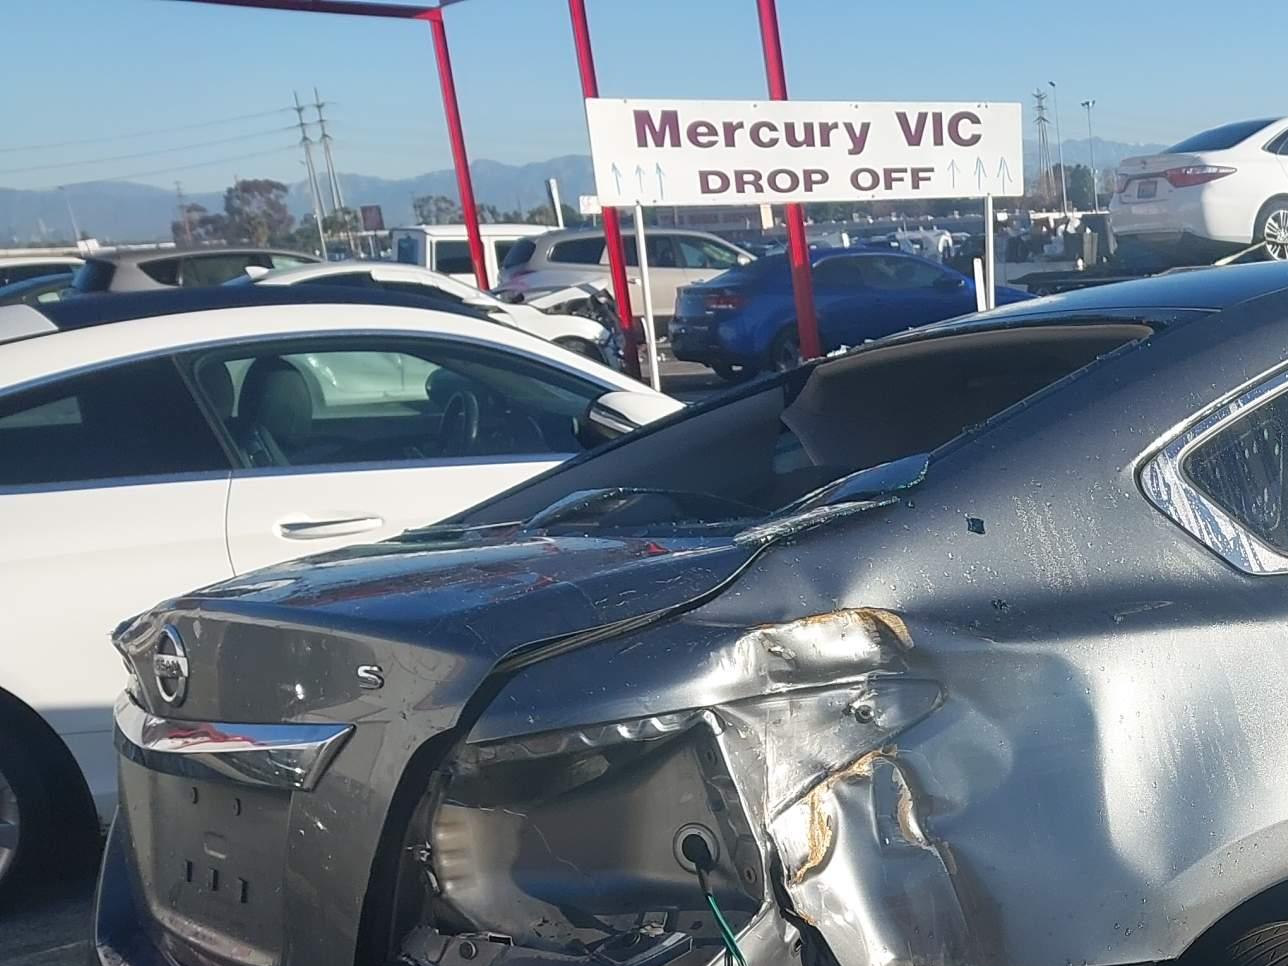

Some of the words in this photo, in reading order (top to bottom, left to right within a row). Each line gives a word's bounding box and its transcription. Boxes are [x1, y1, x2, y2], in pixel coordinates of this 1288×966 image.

[633, 109, 871, 156] Mercury
[895, 110, 983, 148] VIC
[698, 168, 830, 195] DROP
[850, 166, 935, 192] OFF
[356, 664, 386, 690] S
